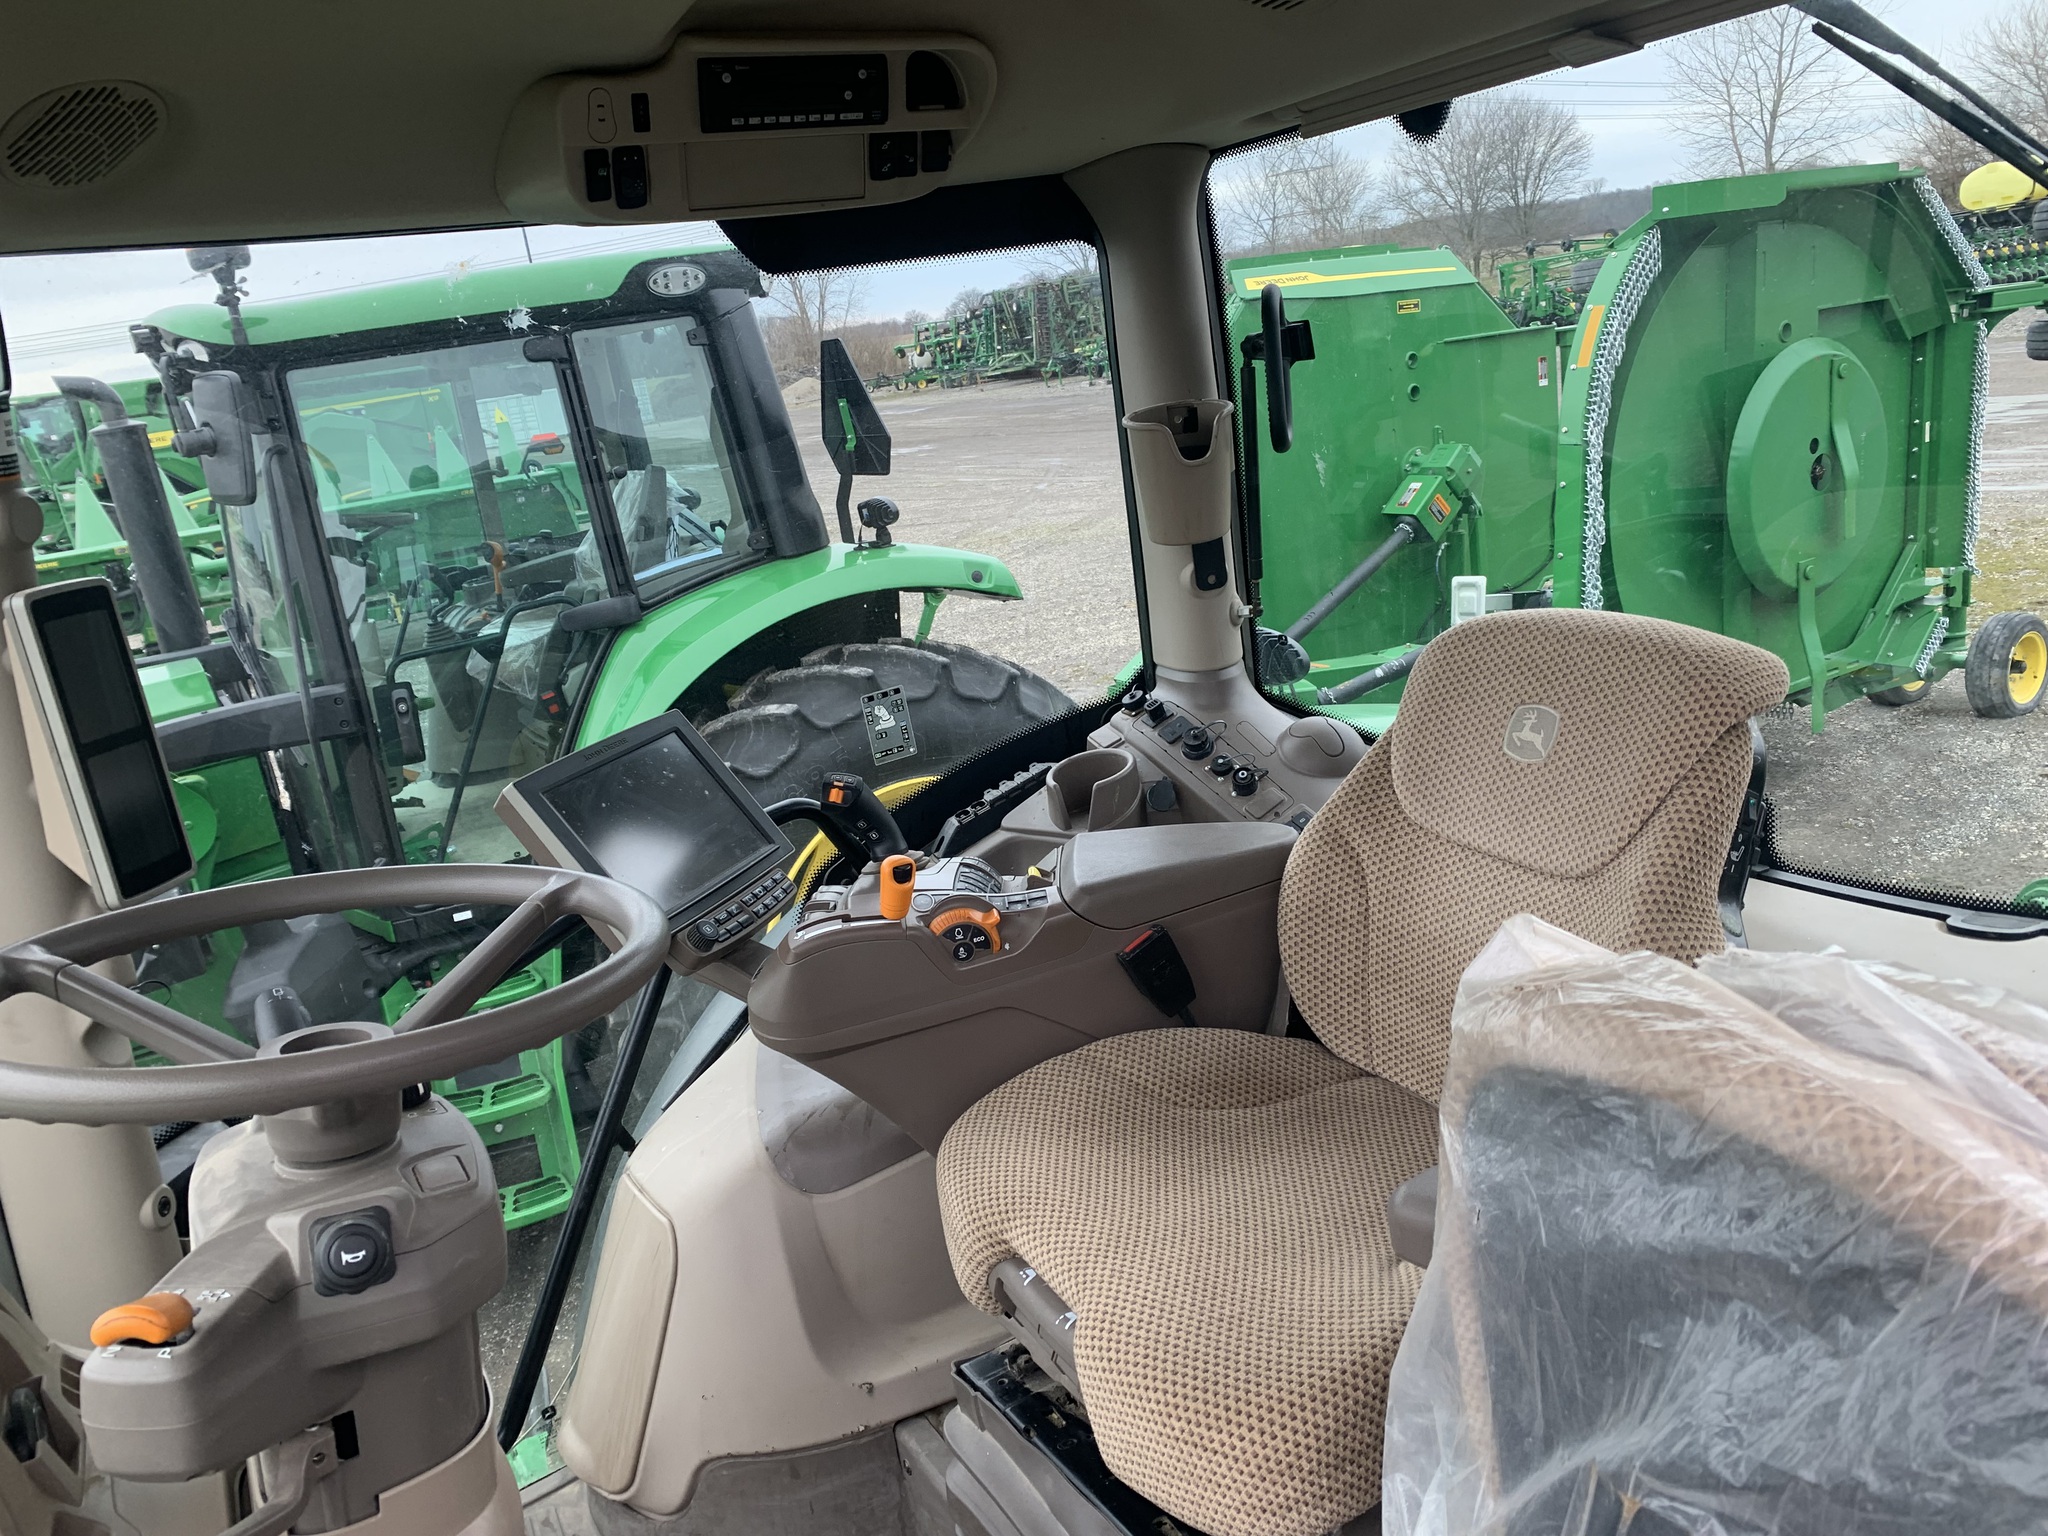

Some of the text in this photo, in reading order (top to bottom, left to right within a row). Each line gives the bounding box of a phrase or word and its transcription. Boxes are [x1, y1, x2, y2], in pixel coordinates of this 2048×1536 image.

[1286, 275, 1309, 283] JOHN
[583, 737, 629, 762] JOHN DEERE
[973, 935, 985, 943] ECO
[156, 1347, 173, 1359] P
